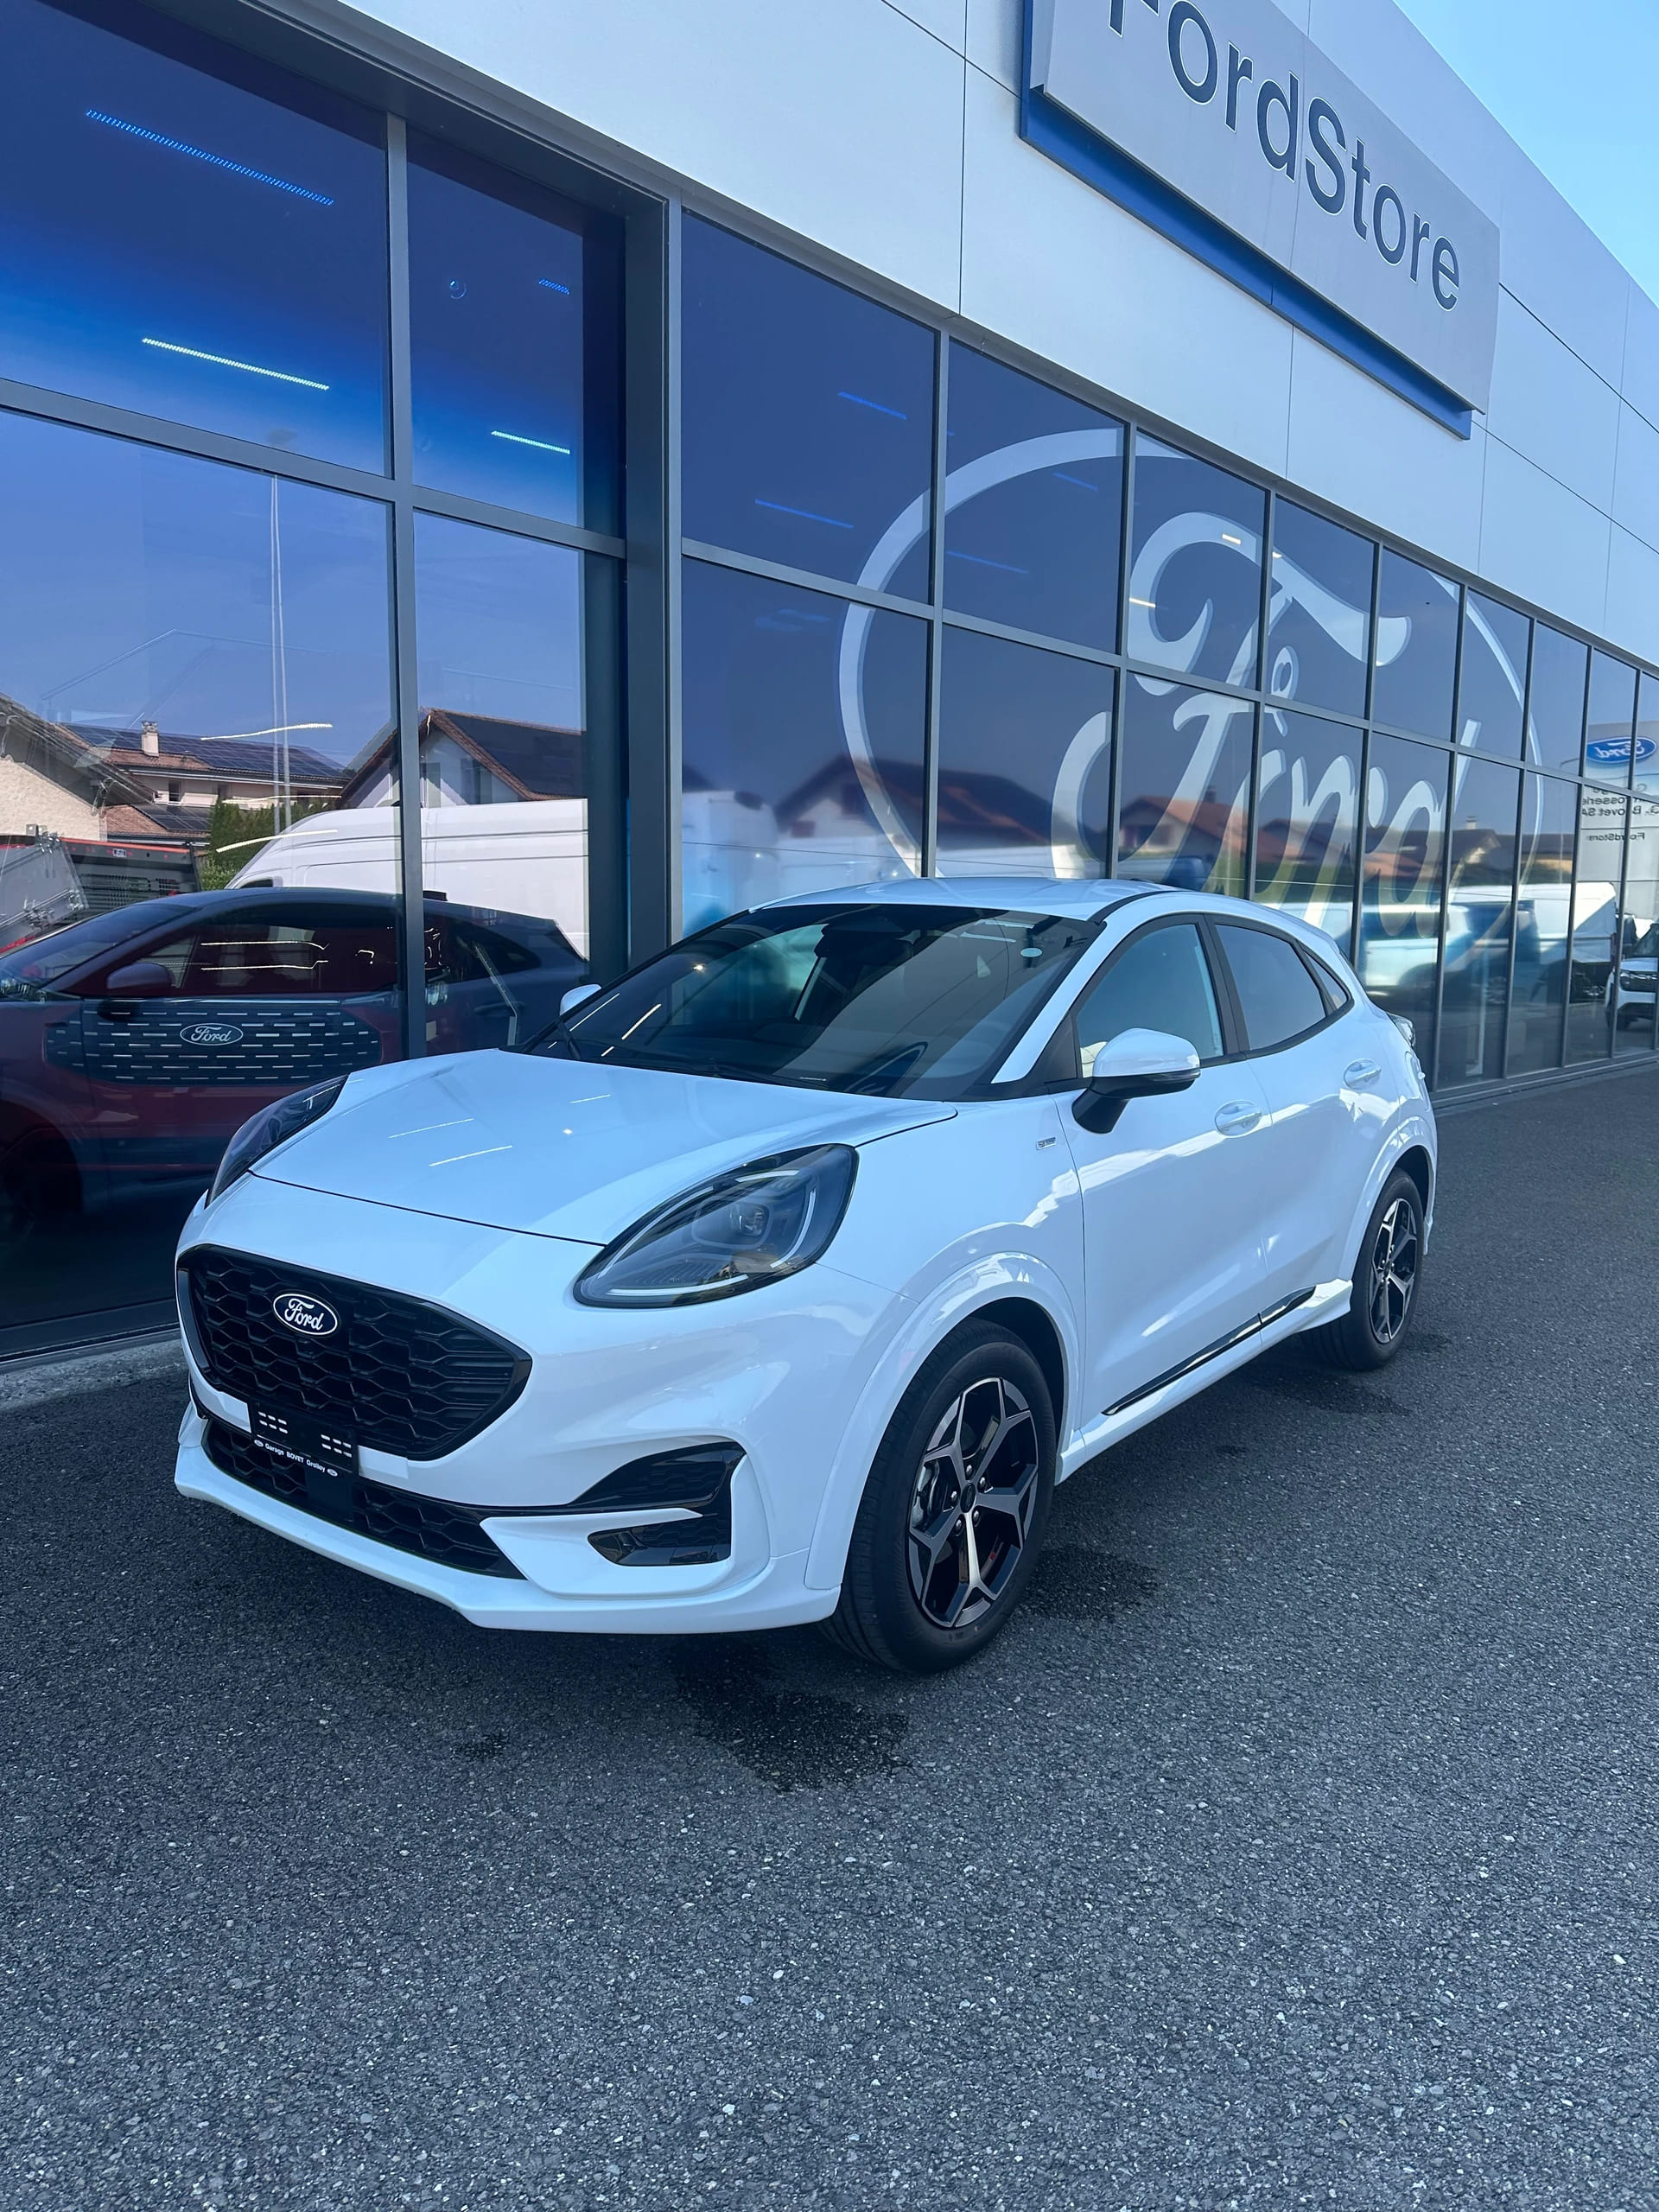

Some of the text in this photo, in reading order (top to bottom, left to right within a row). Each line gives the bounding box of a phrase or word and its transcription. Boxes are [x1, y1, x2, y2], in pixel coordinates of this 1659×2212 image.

[191, 1026, 232, 1042] Ford
[283, 1298, 325, 1332] Ford
[286, 1451, 304, 1464] BOVET
